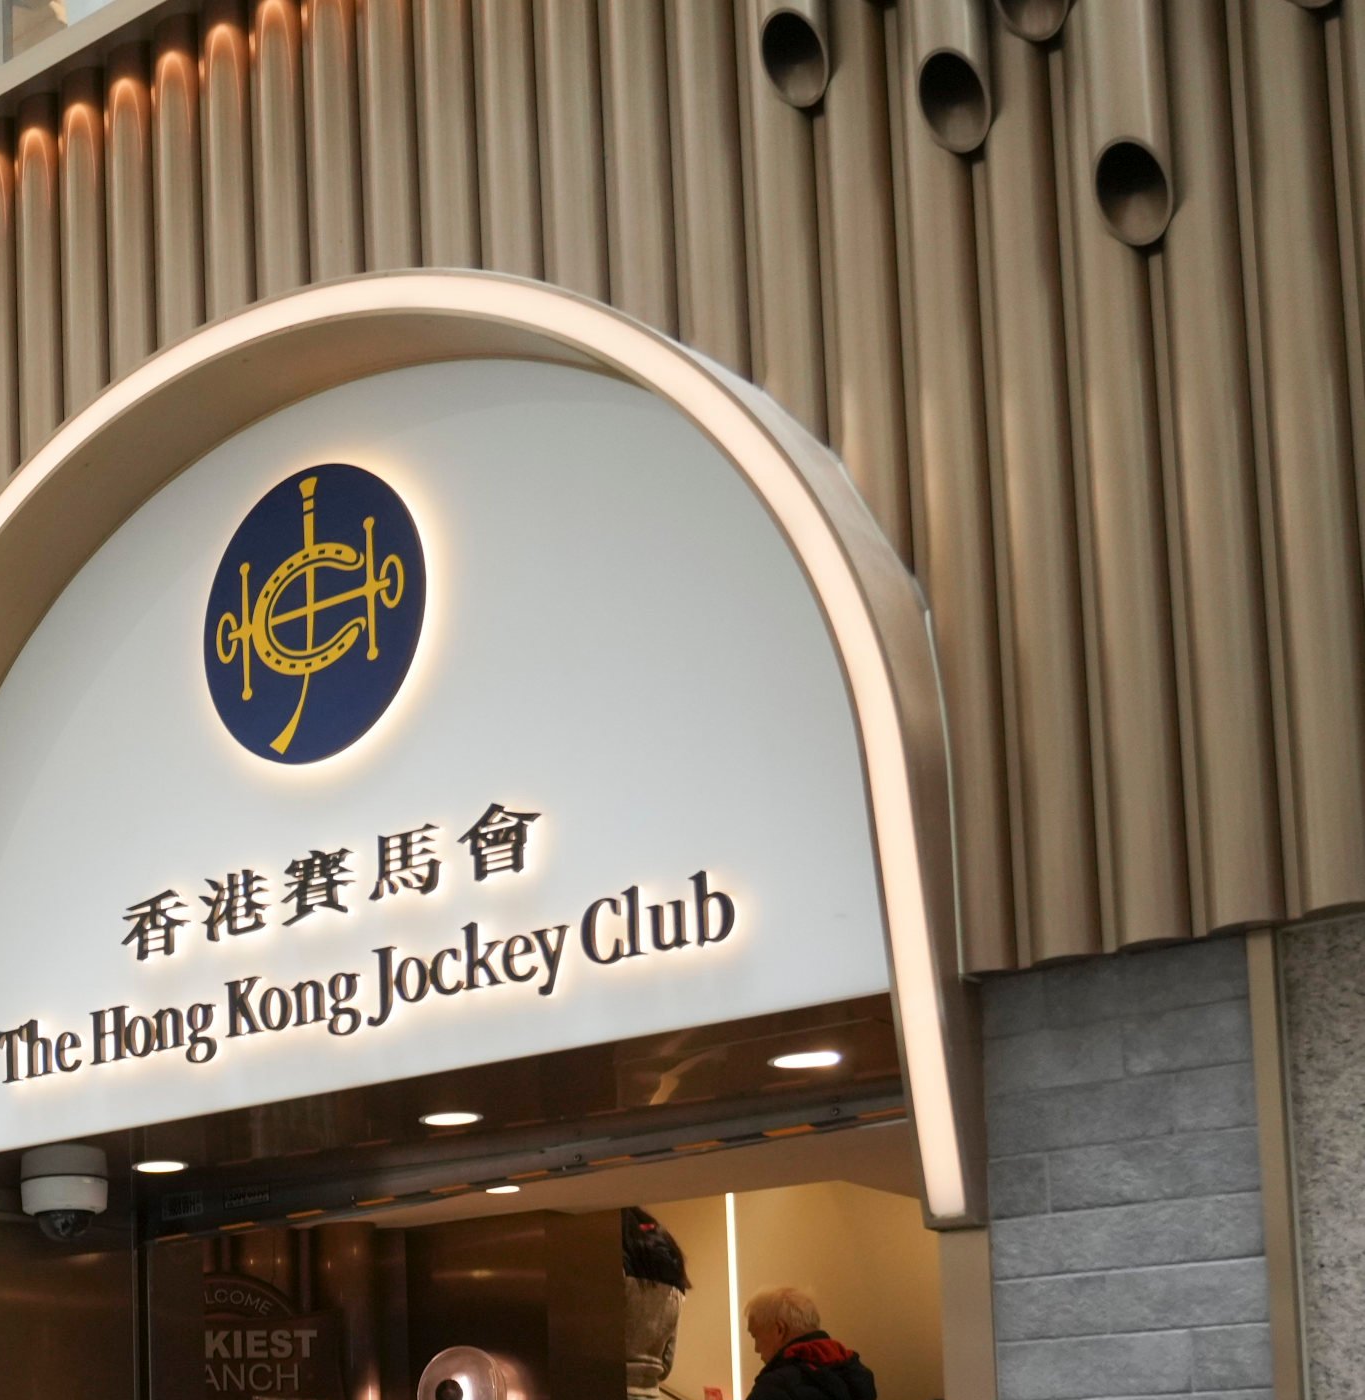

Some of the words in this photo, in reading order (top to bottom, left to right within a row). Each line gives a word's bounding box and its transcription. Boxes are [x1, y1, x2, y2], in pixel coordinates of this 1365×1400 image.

[121, 802, 542, 961] 香港賽馬會
[90, 1002, 217, 1064] Hong
[224, 969, 361, 1037] Kong
[367, 922, 570, 1027] Jockey
[579, 869, 736, 965] Club
[205, 1329, 318, 1359] KIEST
